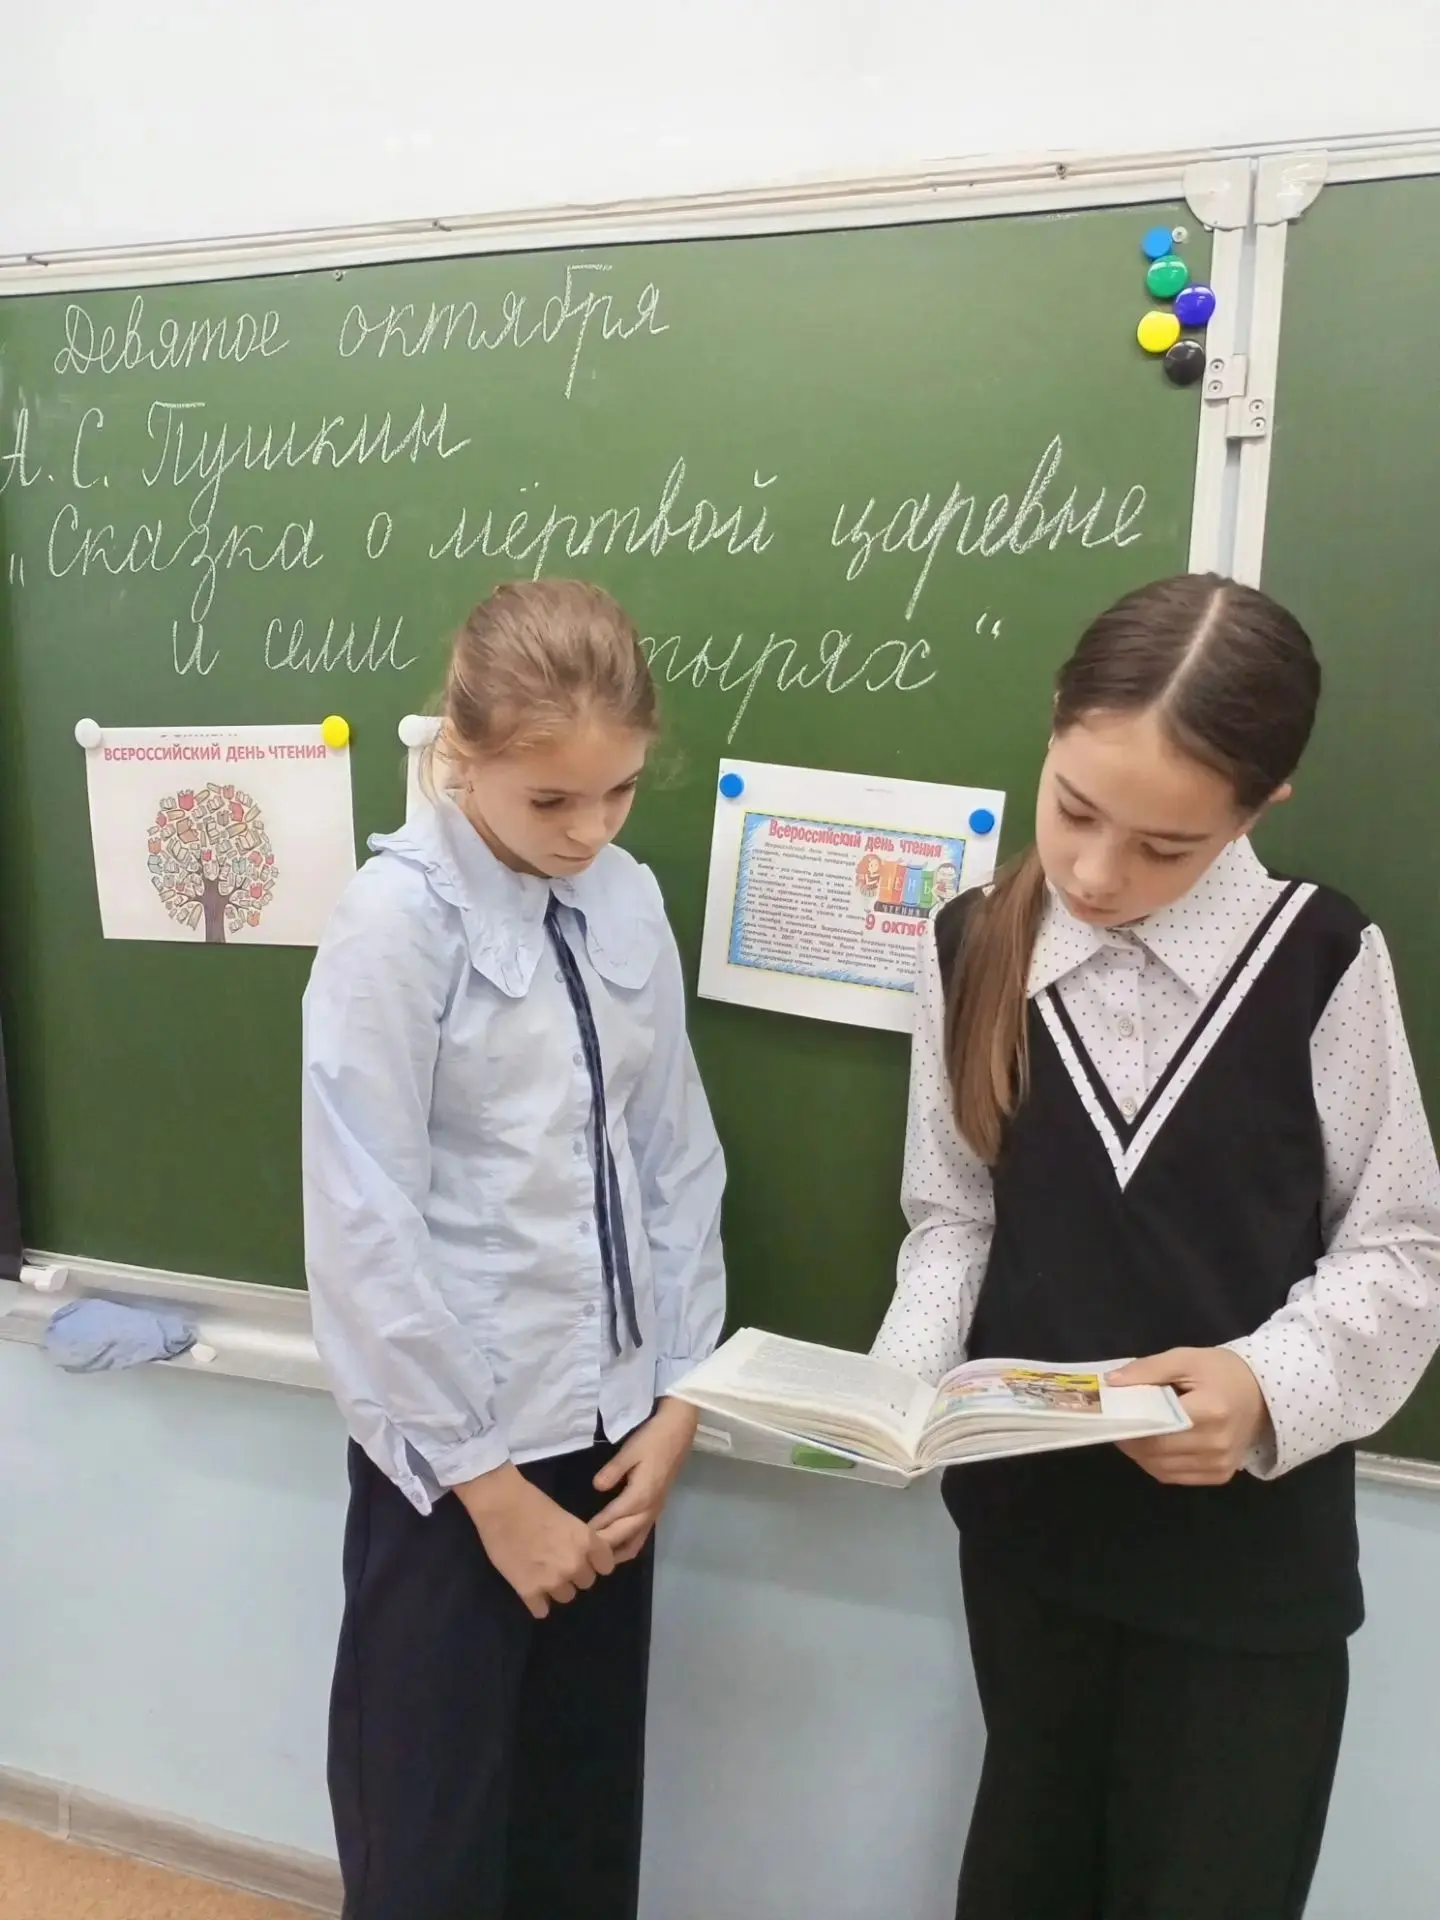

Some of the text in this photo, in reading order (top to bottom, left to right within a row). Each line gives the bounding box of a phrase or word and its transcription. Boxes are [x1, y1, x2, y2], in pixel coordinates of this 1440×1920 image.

[54, 265, 670, 399] Девятое октября
[73, 407, 109, 489] С.
[142, 402, 471, 528] Пушкин
[366, 511, 392, 559] о
[429, 456, 778, 581] мёртвой
[831, 434, 1147, 620] царевне
[172, 618, 220, 675] и
[264, 615, 420, 673] семи
[103, 742, 327, 763] ВСЕРОССИЙСКИЙ ДЕНЬ ЧТЕНИЯ
[768, 818, 943, 858] Всероссийский день чтения
[864, 913, 928, 937] 9 октяб
